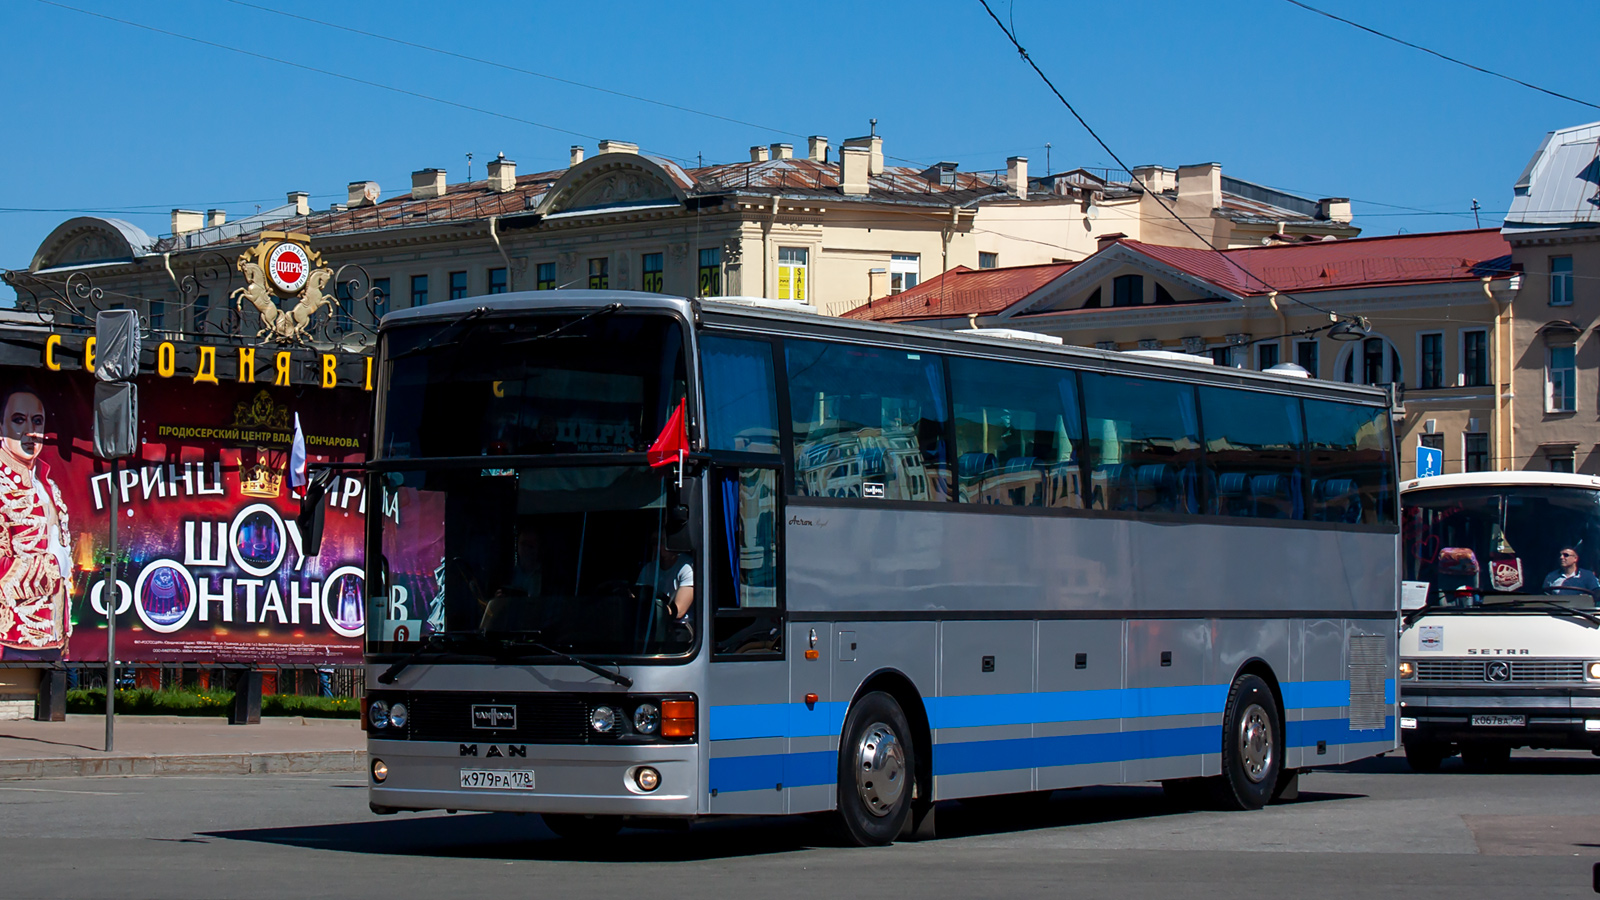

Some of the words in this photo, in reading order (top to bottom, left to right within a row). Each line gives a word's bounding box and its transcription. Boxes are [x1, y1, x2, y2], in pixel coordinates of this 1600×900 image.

[277, 261, 303, 274] ЦИРК
[46, 335, 291, 387] СЕОДНЯ
[159, 425, 239, 440] ПРОДЮСЕРСКИЙ
[241, 429, 272, 442] ЦЕНТР
[306, 435, 359, 448] ГОНЧАРОВА
[91, 461, 224, 510] ПРИНЦ
[460, 743, 527, 758] MAN
[511, 773, 530, 784] 178
